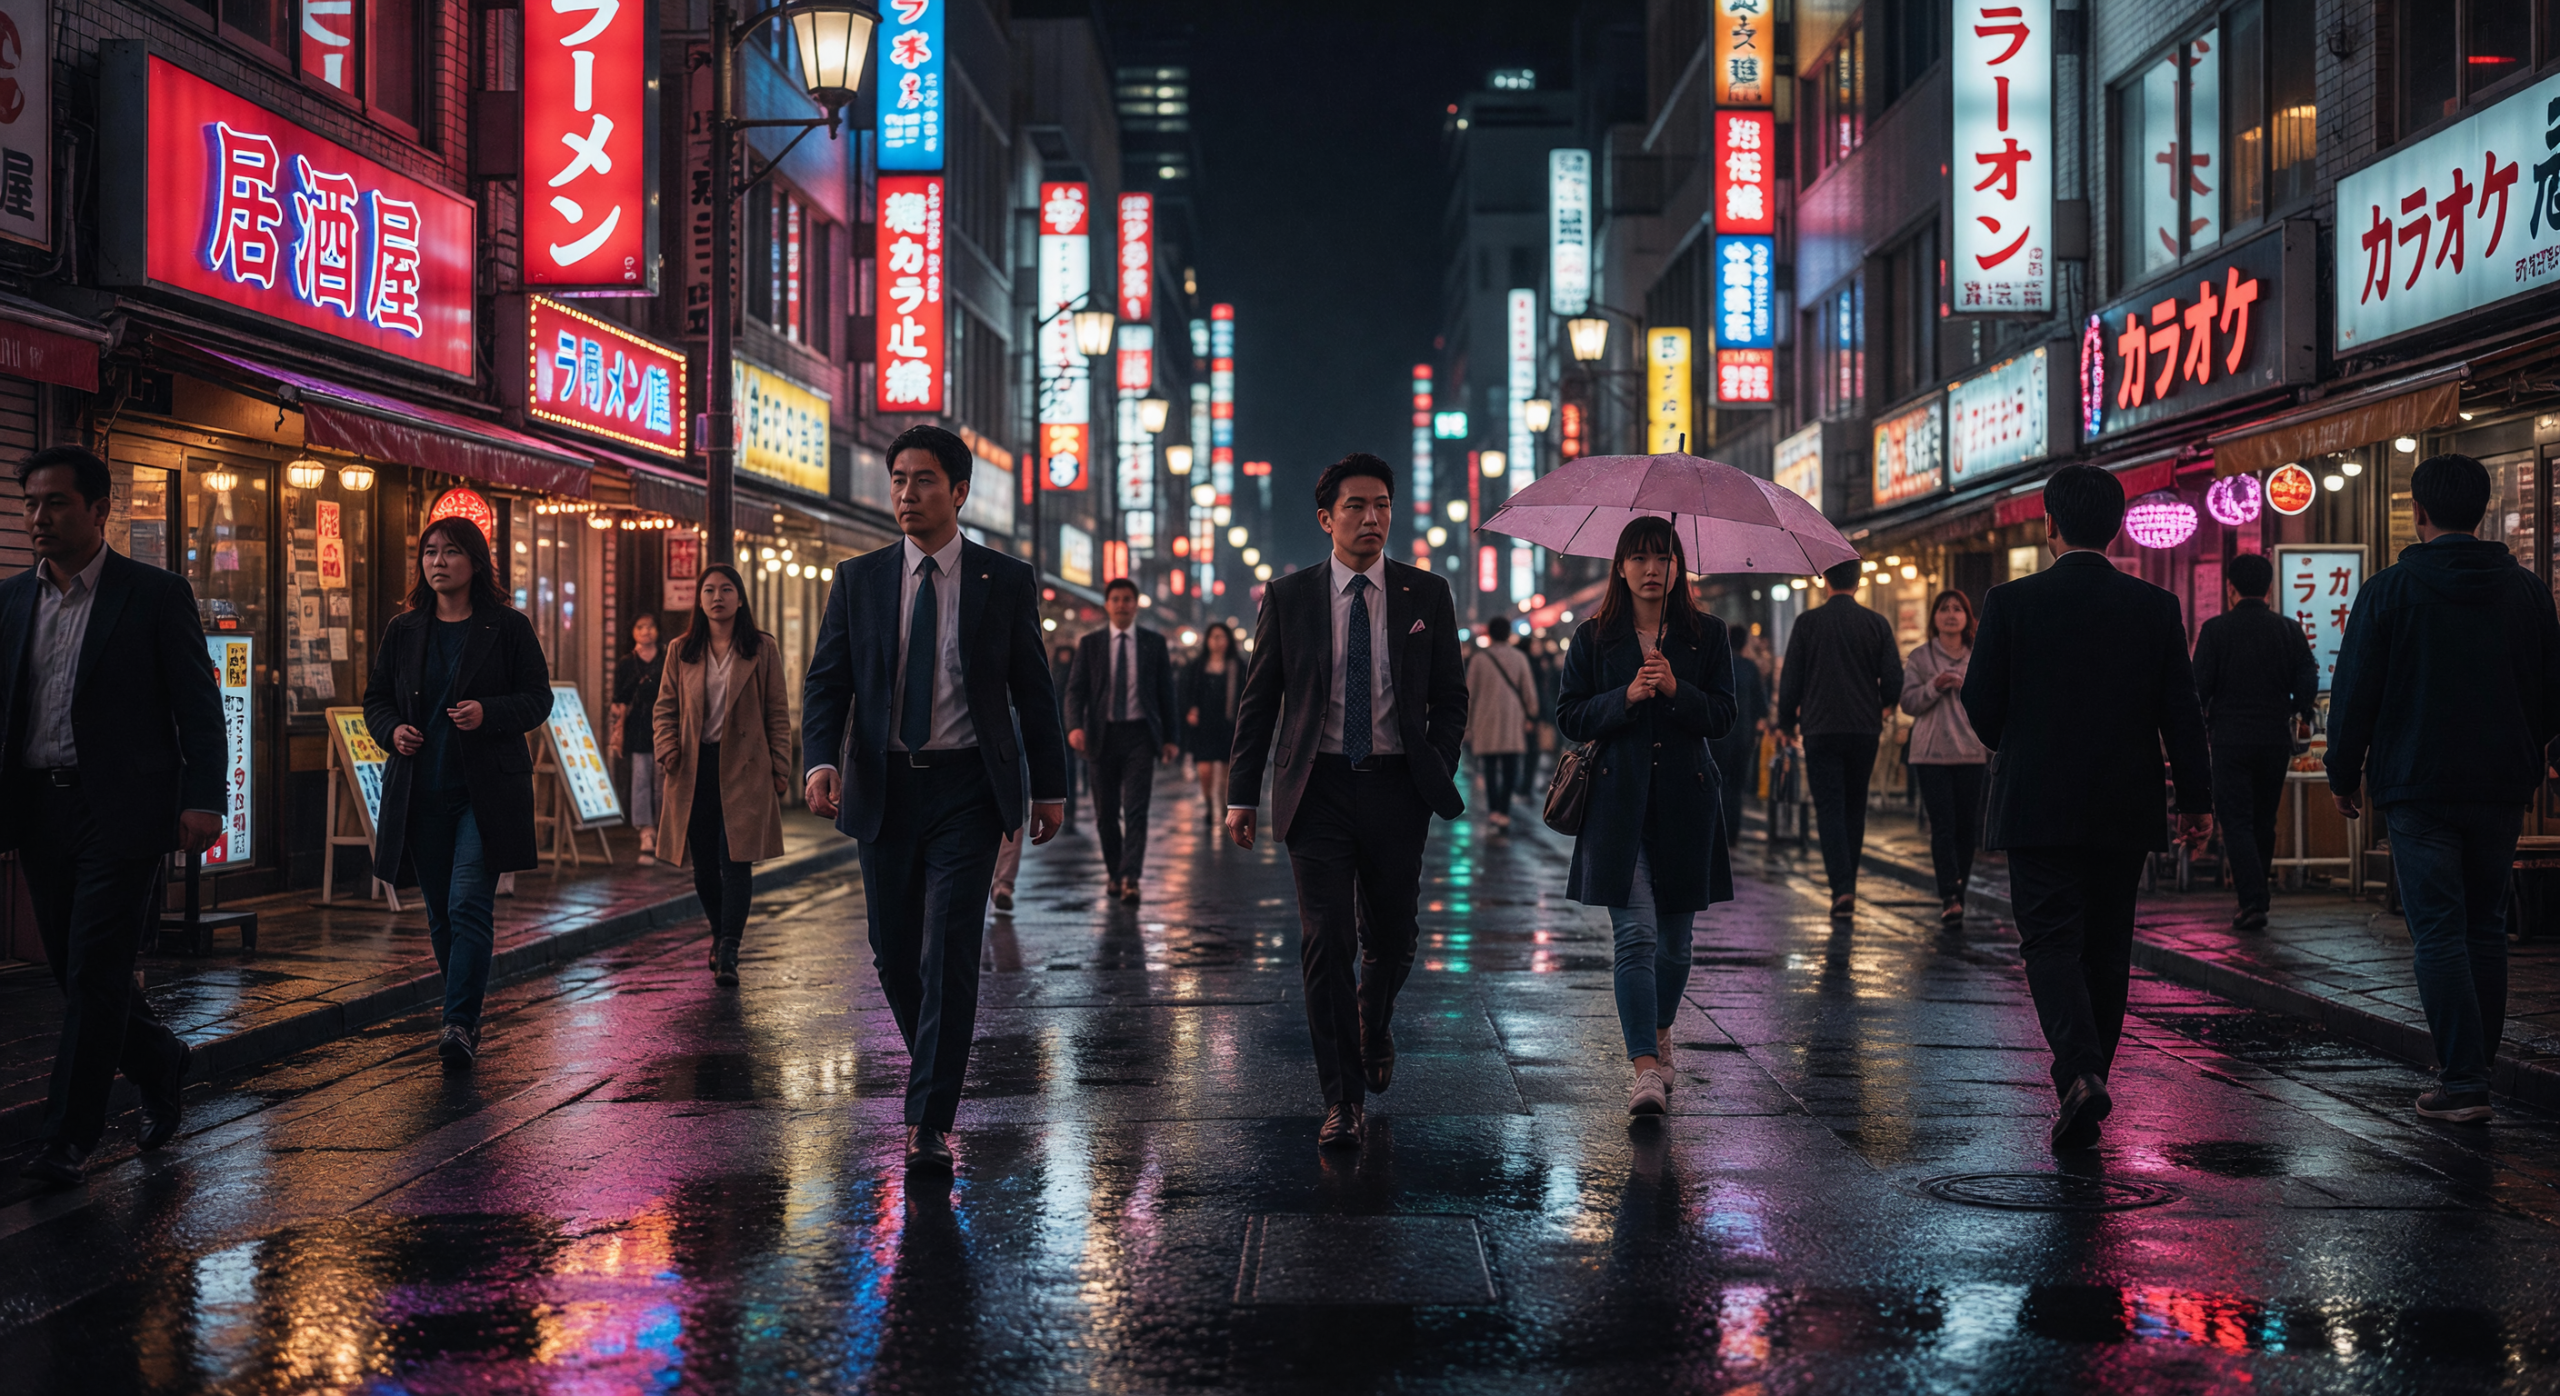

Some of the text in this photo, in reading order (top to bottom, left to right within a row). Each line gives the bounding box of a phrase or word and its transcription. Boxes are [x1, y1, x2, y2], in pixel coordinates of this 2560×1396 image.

[208, 121, 424, 339] 居酒屋
[1973, 6, 2032, 271] ラーオン
[2360, 150, 2519, 306] カラオケ
[2117, 266, 2258, 410] カラオケ
